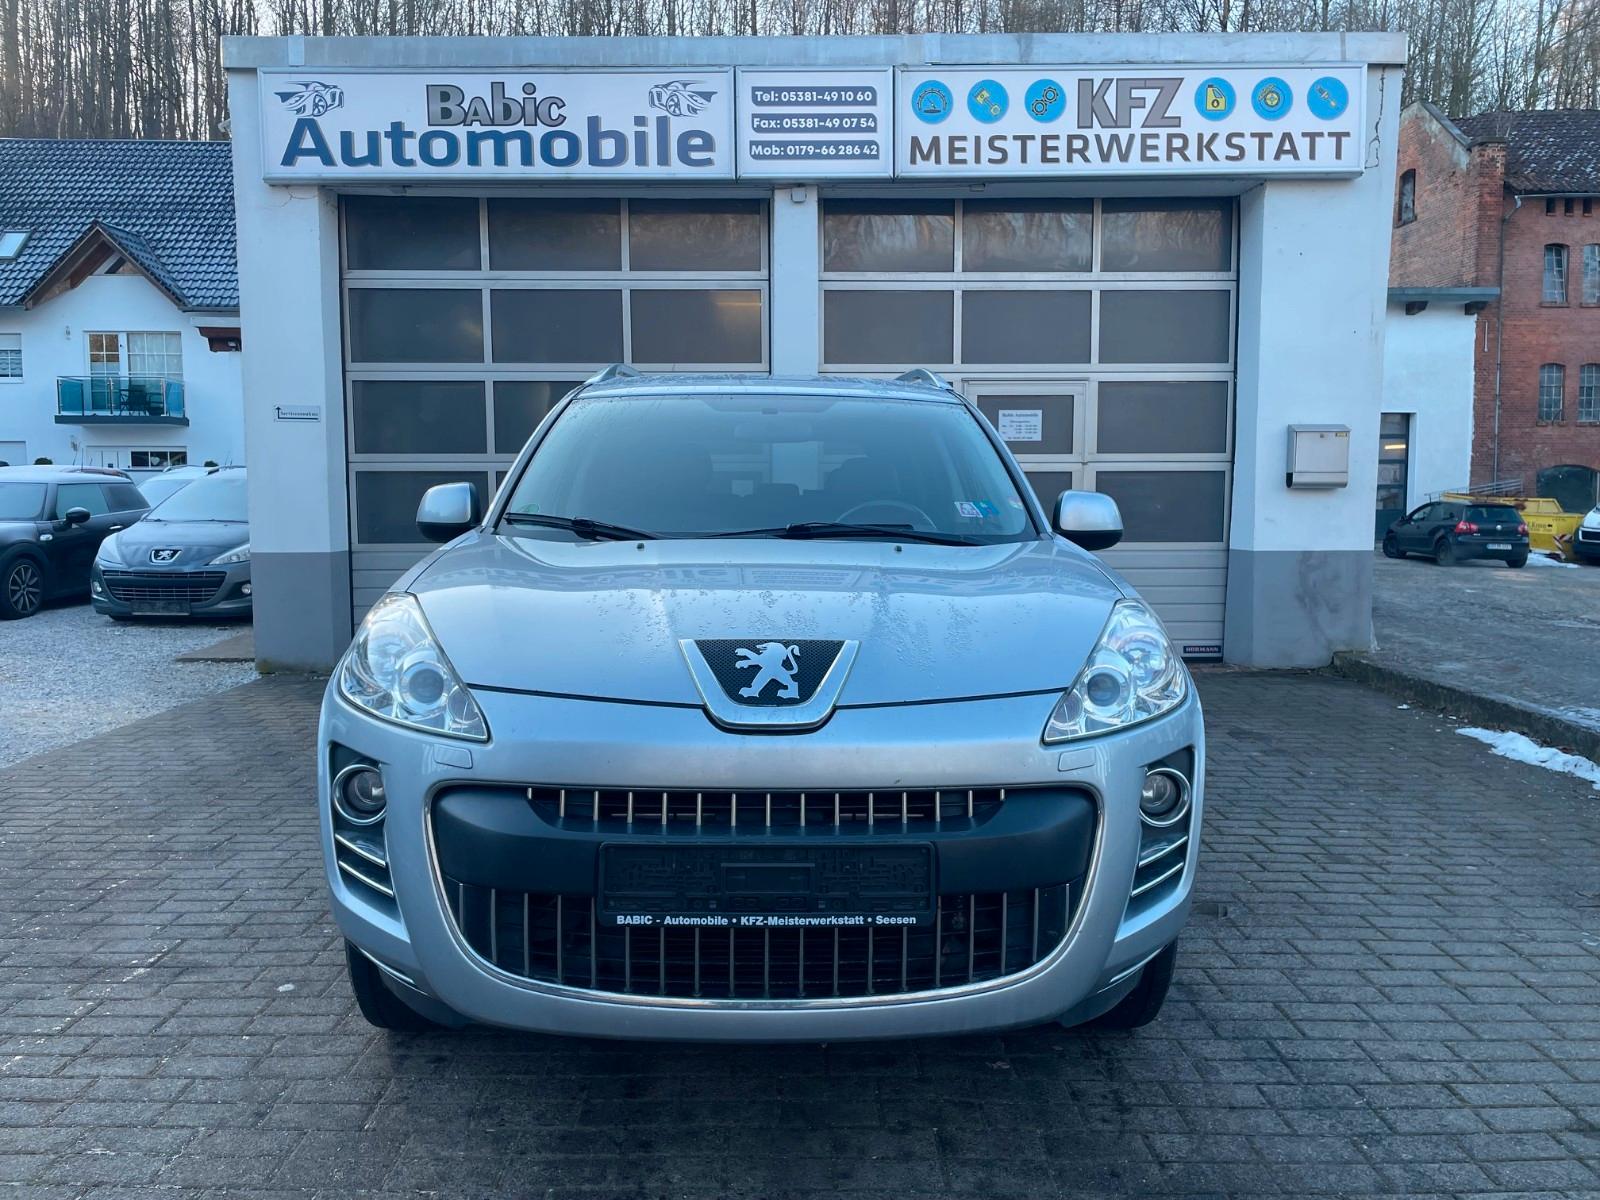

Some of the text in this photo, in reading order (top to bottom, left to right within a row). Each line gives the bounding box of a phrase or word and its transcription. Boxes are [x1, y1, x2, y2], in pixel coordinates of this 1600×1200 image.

[755, 91, 872, 101] Tel: 05381-49 10 60
[1077, 77, 1184, 129] KFZ
[753, 118, 875, 128] Fax: 05381-49 07 54
[280, 116, 716, 167] Automobile
[751, 145, 878, 155] Mob: 0179-66 286 42
[909, 131, 1351, 165] MEISTERWERKSTATT
[616, 915, 653, 925] BABIC
[664, 915, 728, 925] Automobile
[740, 915, 864, 926] KFZ-Meisterwerkstatt
[875, 915, 917, 925] Seesen
